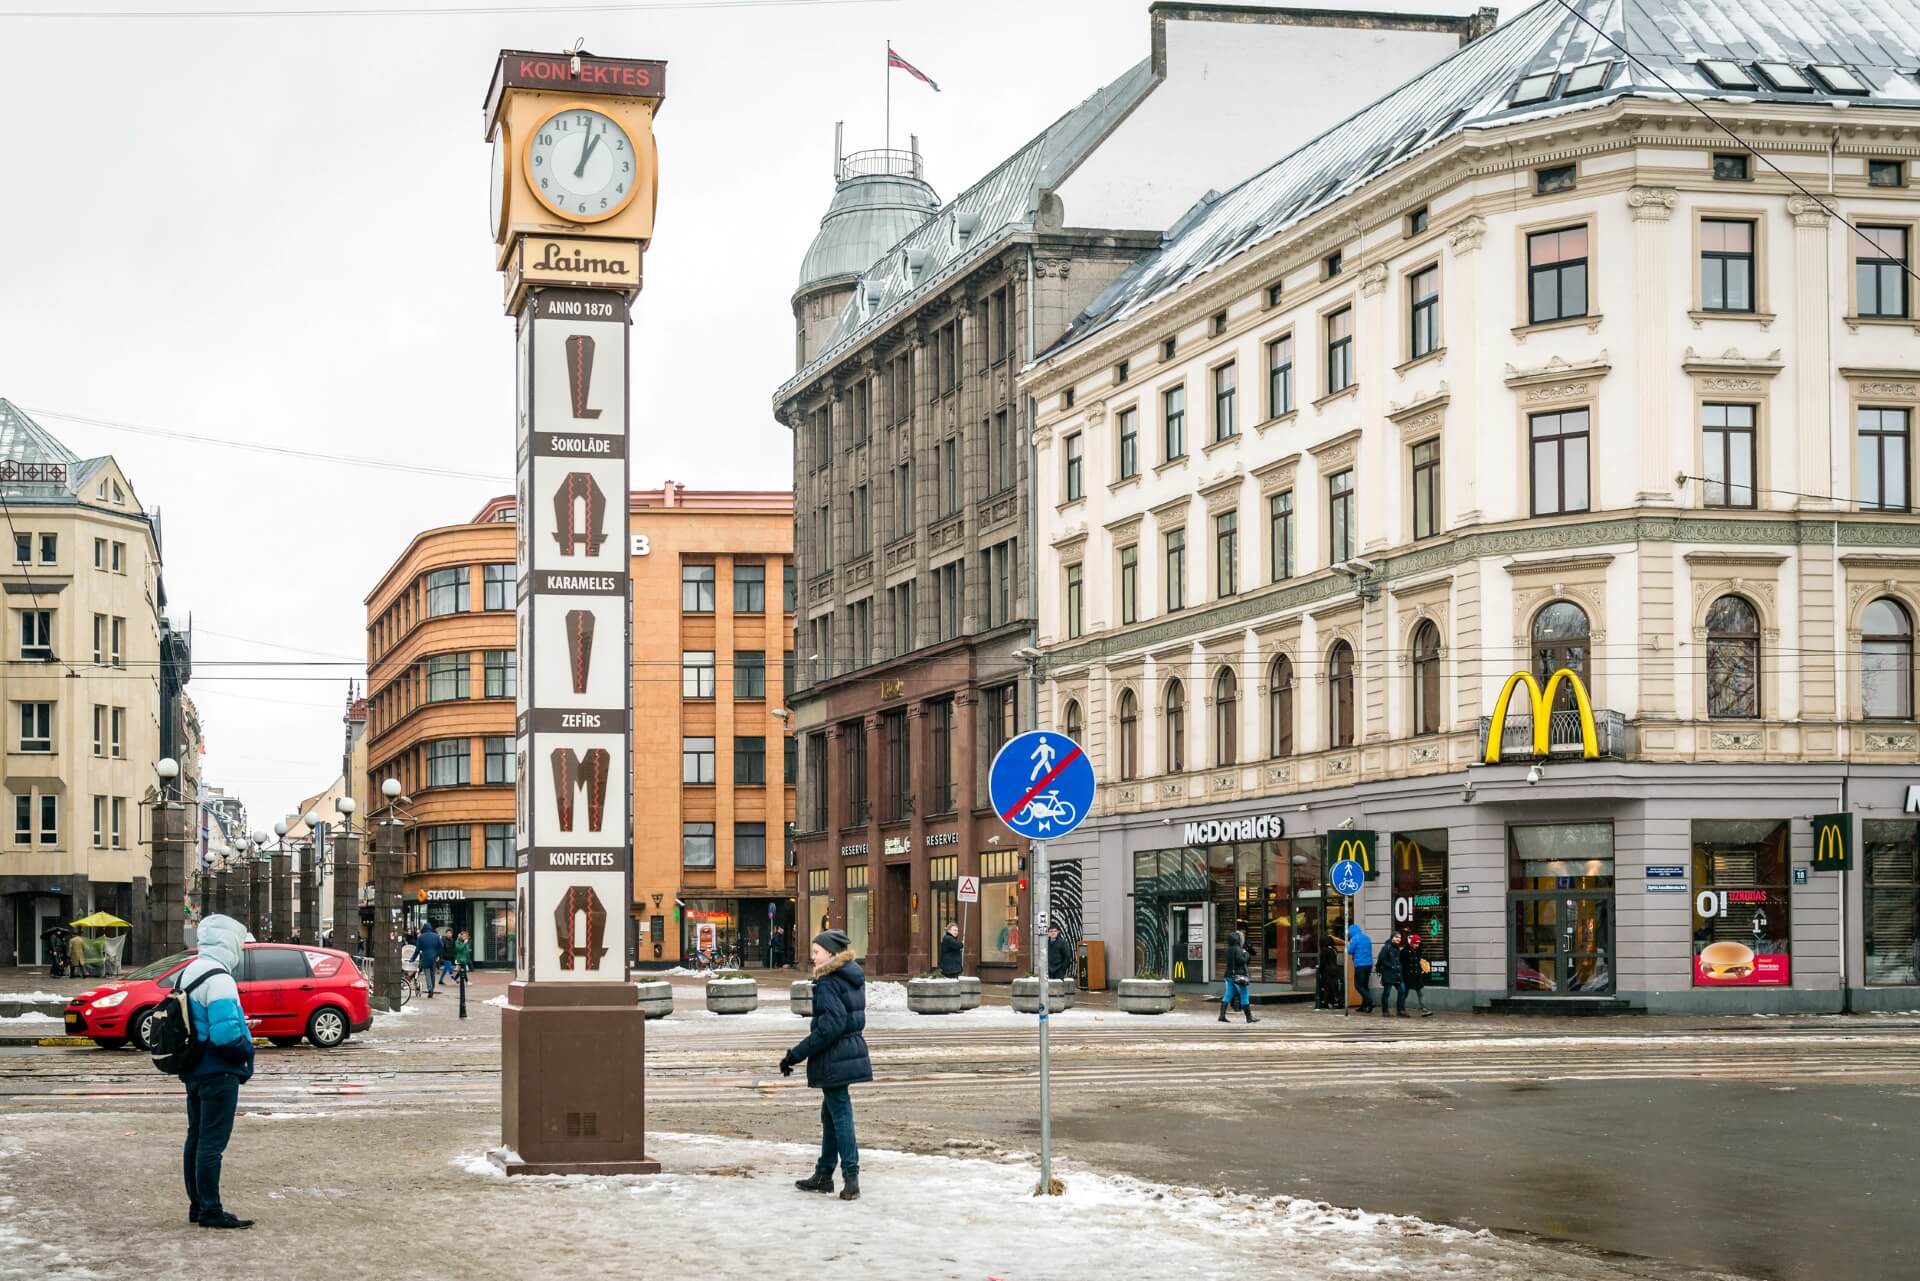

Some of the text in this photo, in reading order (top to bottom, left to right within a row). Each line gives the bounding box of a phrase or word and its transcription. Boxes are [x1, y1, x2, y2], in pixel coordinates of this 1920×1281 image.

[520, 61, 650, 86] KONEKTES
[555, 120, 568, 131] 11
[601, 123, 607, 134] 1
[539, 134, 552, 146] 10
[616, 140, 624, 151] 2
[535, 156, 543, 167] 9
[622, 161, 630, 173] 3
[541, 178, 548, 189] 8
[616, 183, 624, 194] 4
[557, 195, 564, 206] 7
[600, 198, 608, 208] 5
[578, 203, 586, 213] 6
[533, 243, 630, 275] Laima
[549, 301, 613, 316] ANNO 1870
[551, 436, 610, 453] ŠOKOLĀDE
[547, 576, 615, 590] KARAMELES
[562, 712, 601, 728] ZEFĪRS
[1184, 815, 1282, 845] McDonald's
[549, 853, 614, 866] KONFEKTES
[427, 890, 466, 900] STATOIL
[1395, 897, 1413, 922] O!
[1697, 891, 1727, 918] O!
